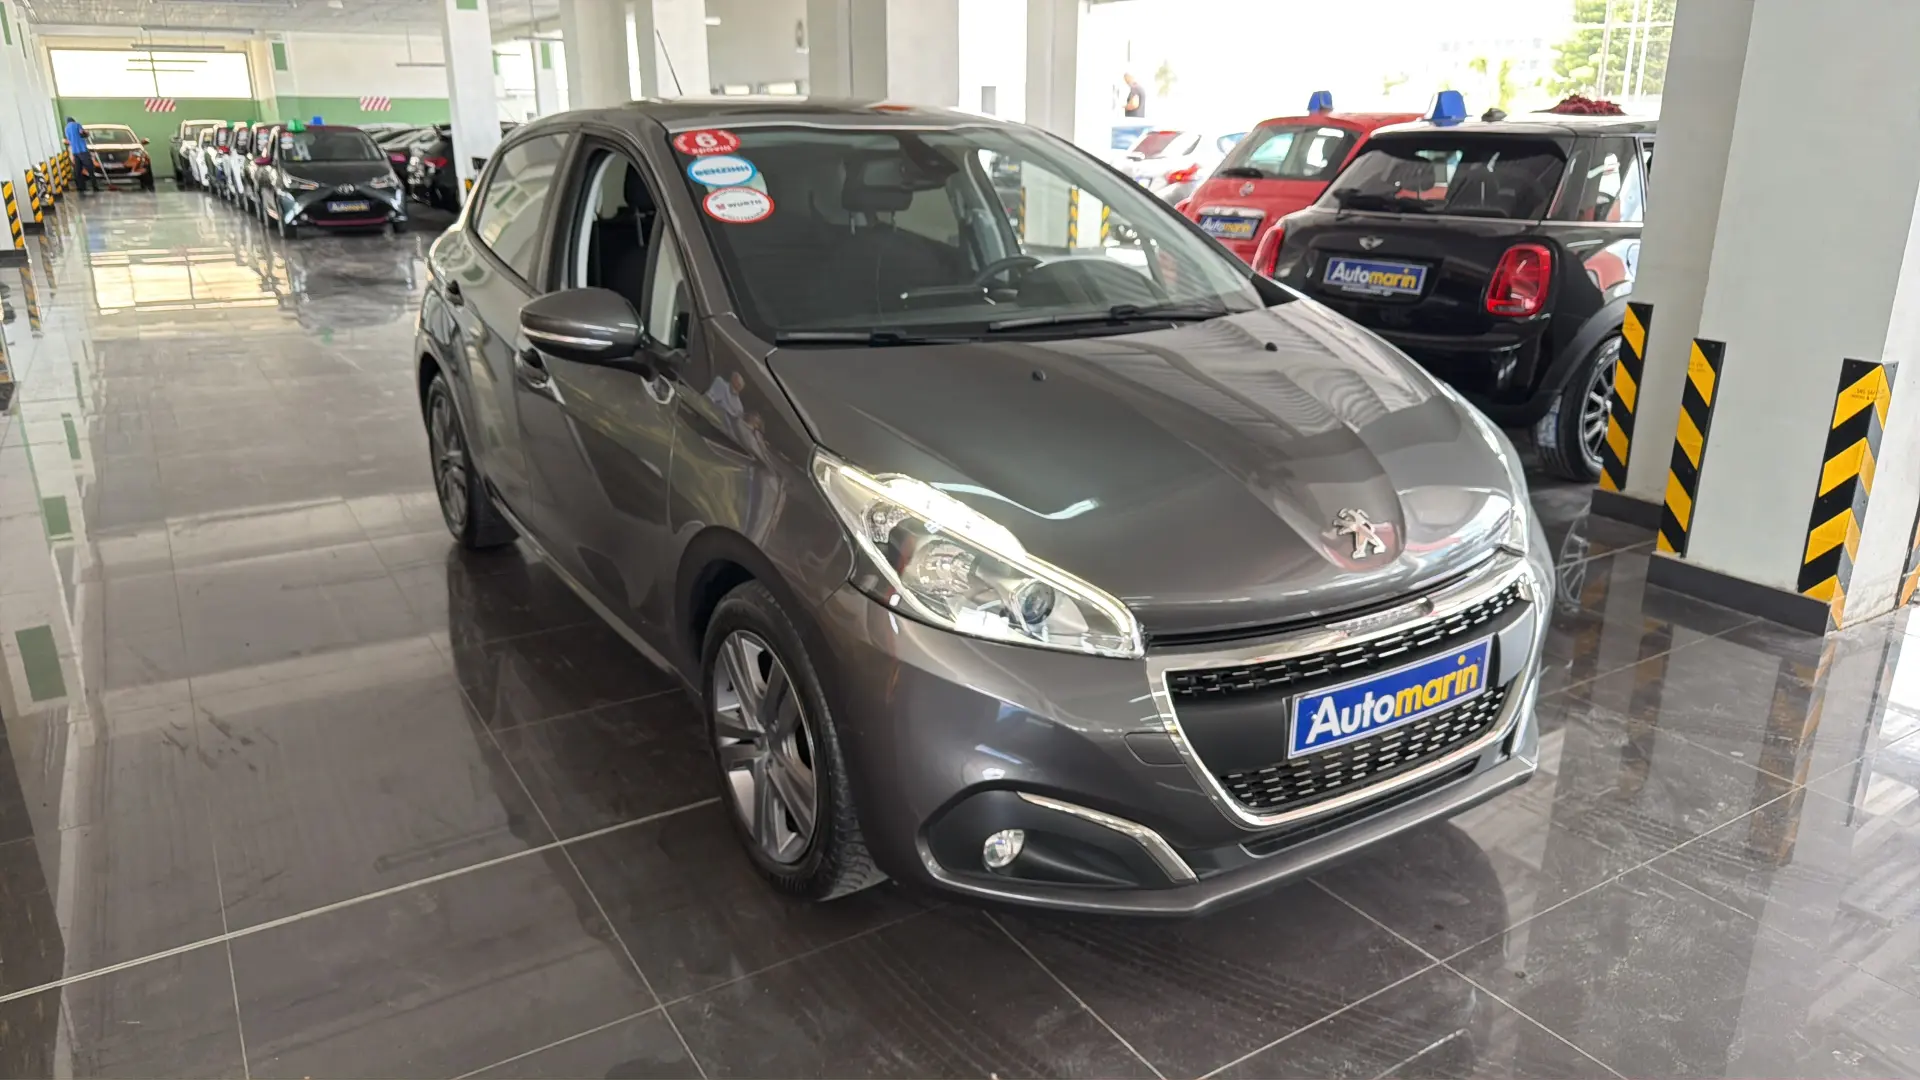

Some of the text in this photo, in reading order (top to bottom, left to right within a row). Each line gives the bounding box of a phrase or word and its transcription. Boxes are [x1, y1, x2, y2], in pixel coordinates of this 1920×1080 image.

[695, 131, 717, 147] 6
[1201, 216, 1251, 233] Automarin
[1330, 262, 1417, 289] Automarin
[1304, 653, 1480, 744] Automarin
